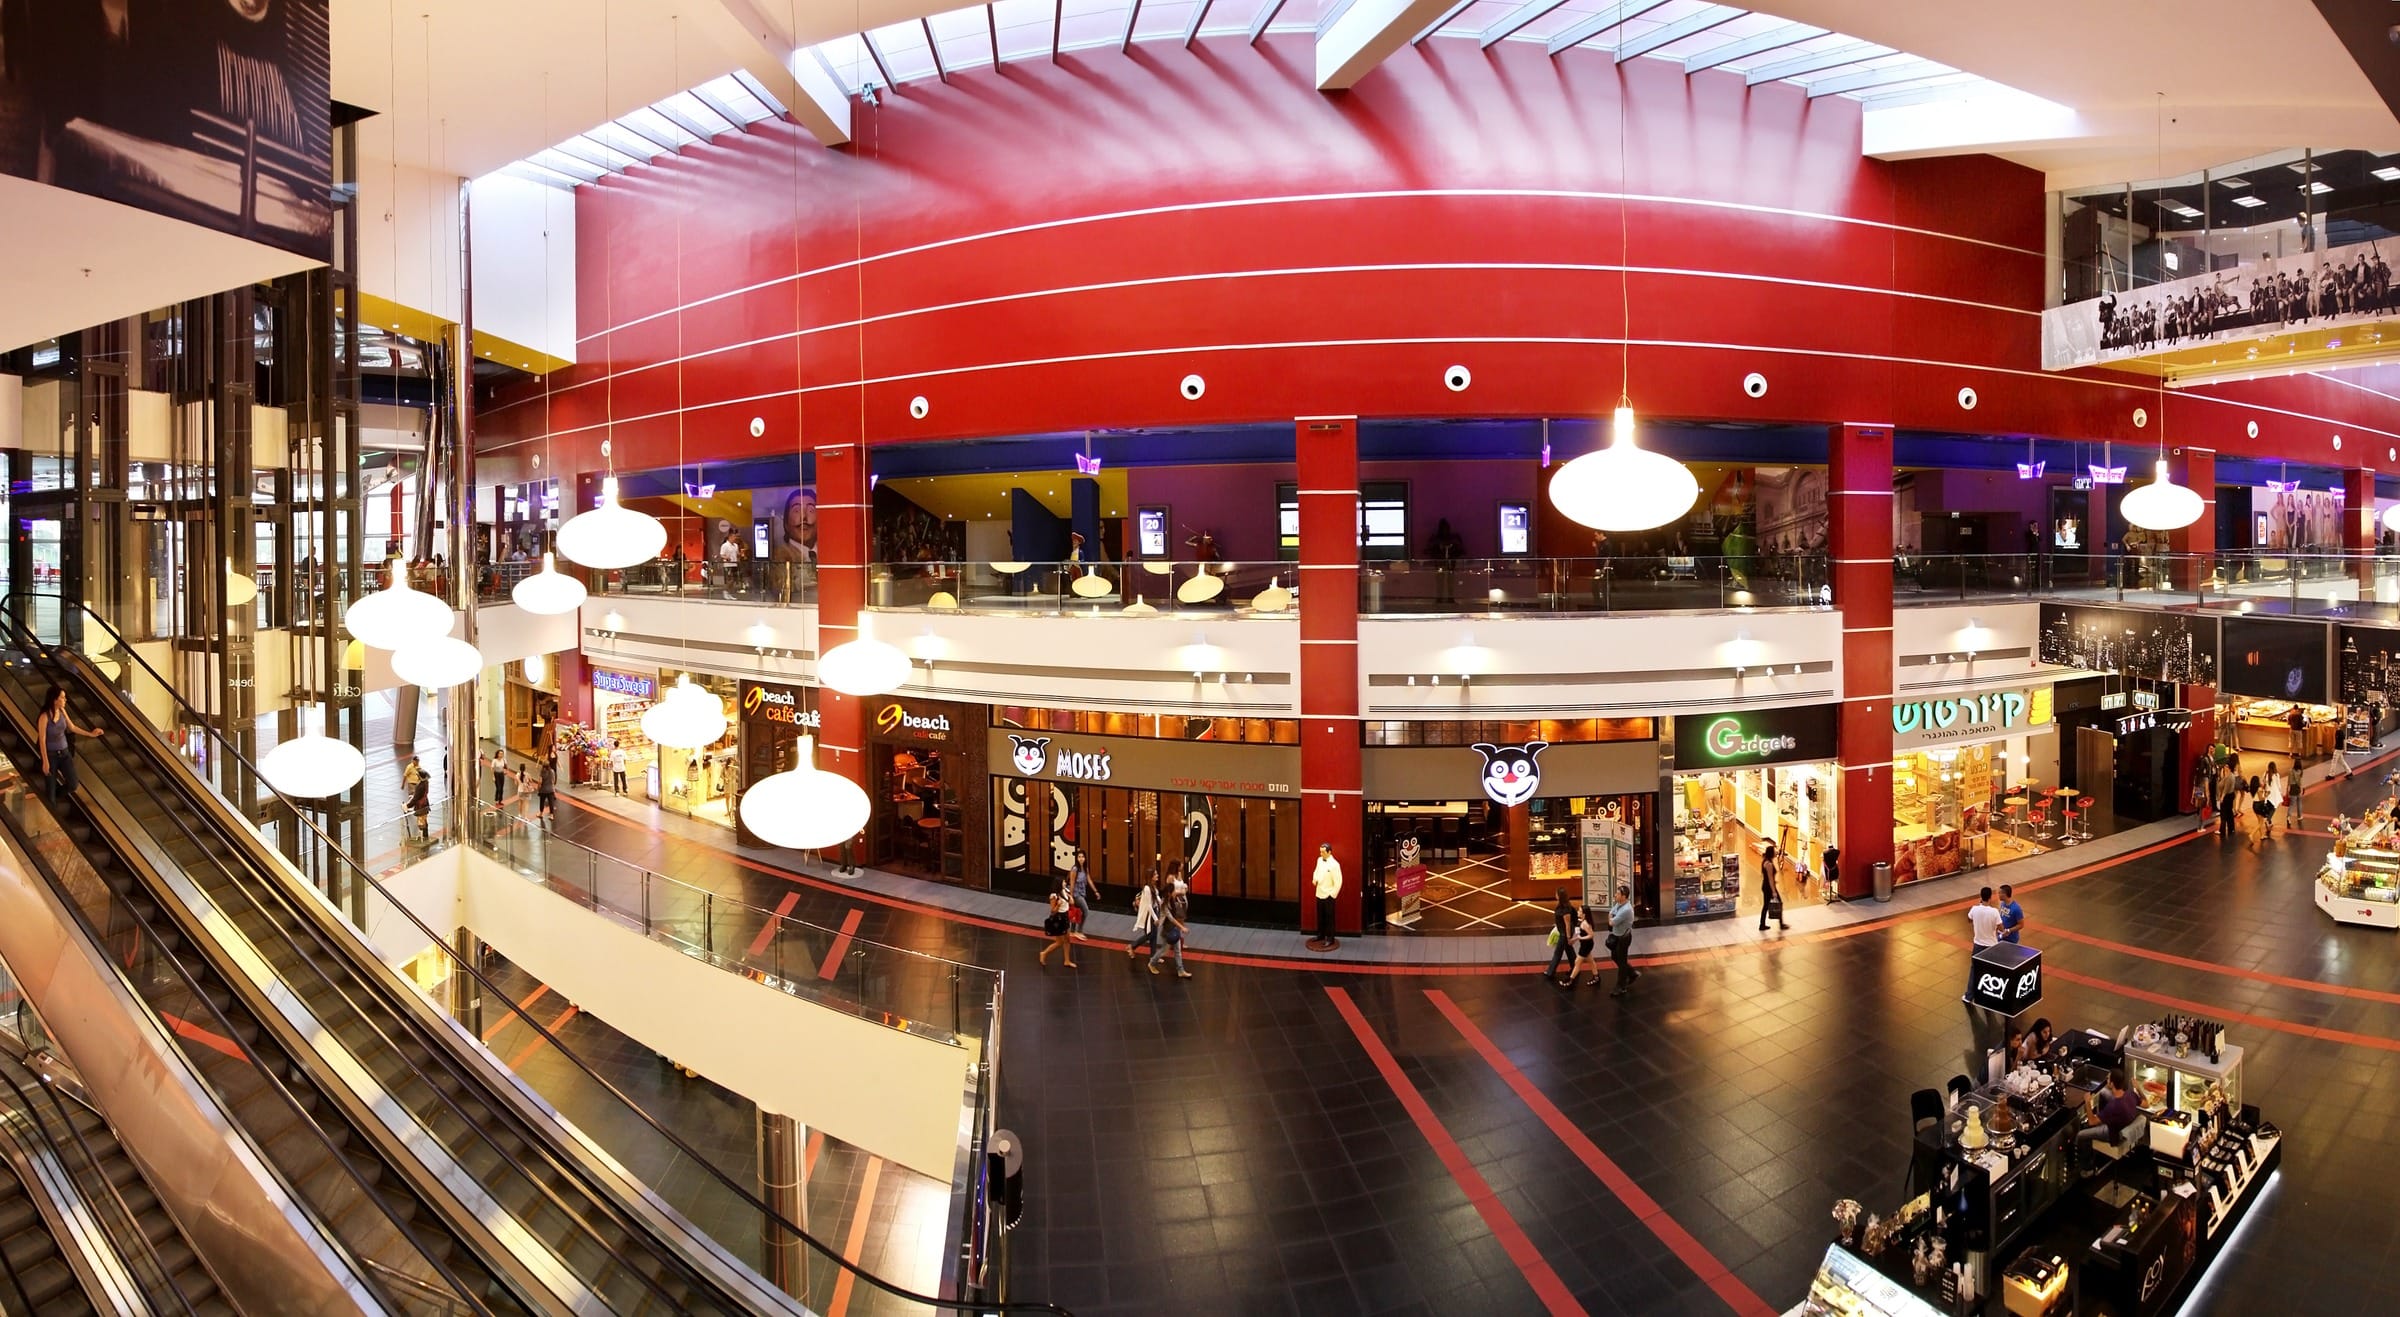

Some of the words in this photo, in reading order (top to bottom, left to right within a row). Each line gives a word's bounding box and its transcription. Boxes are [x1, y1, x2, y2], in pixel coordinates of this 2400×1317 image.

[1145, 519, 1159, 530] 20
[1508, 514, 1521, 526] 21
[761, 688, 795, 705] beach
[902, 711, 950, 731] beach
[1892, 692, 2025, 734] קיורטוש
[1268, 783, 1289, 793] מוזס
[1977, 973, 2010, 1001] ROY
[2016, 965, 2040, 999] ROY
